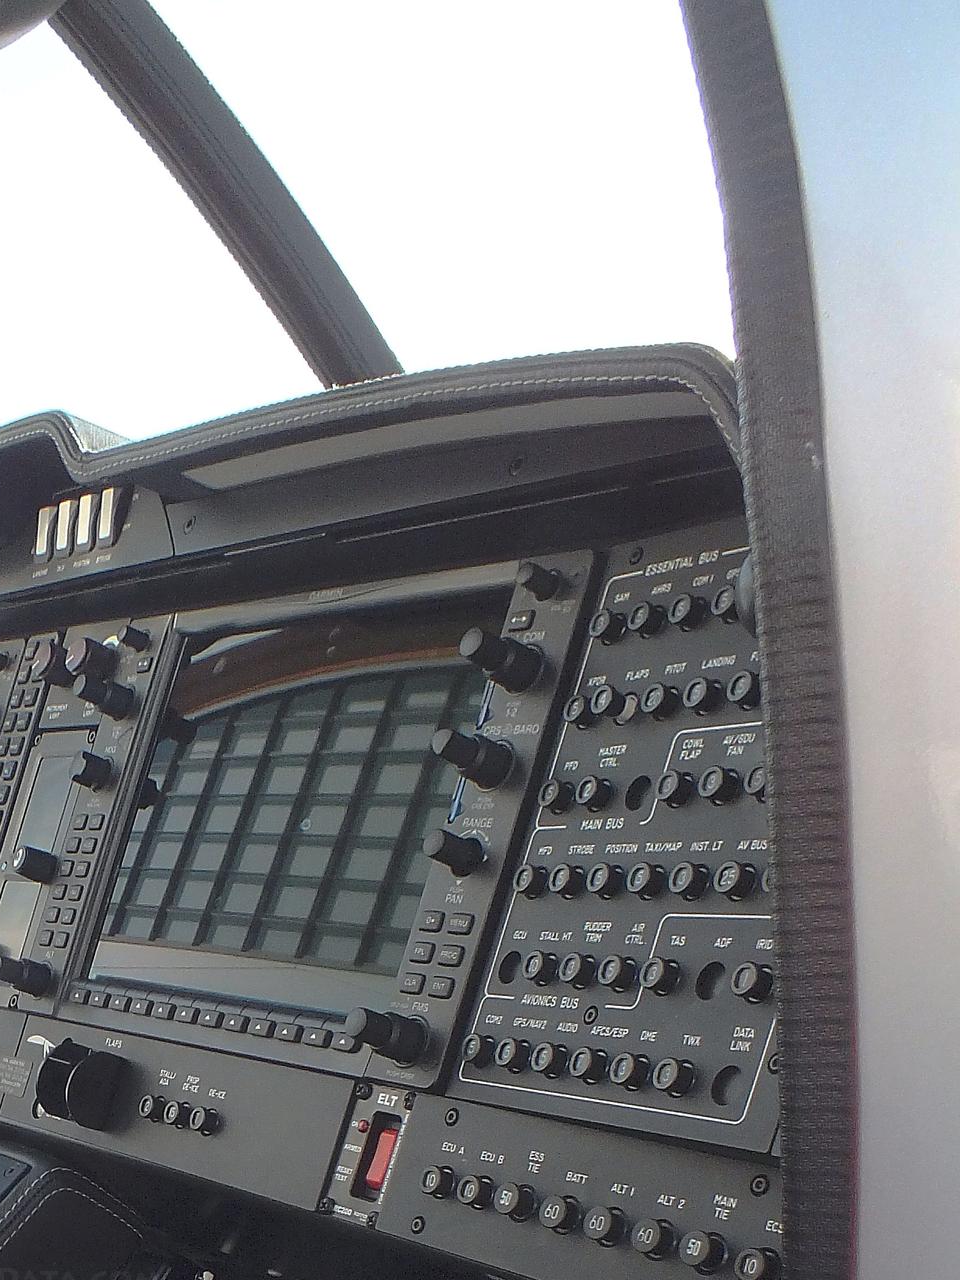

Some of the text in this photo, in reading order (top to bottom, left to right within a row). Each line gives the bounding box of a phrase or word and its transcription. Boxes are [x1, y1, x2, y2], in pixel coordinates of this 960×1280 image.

[645, 551, 719, 576] ESSENTIAL BUS
[523, 632, 545, 643] COM
[701, 655, 736, 669] LANDING
[625, 668, 650, 681] FLAPS
[665, 662, 688, 675] PITOT
[514, 724, 539, 735] BARO
[682, 738, 705, 749] COWL
[598, 745, 628, 756] MASTER
[679, 749, 702, 760] FLAP
[726, 746, 744, 756] FAN
[564, 761, 579, 771] PFD
[462, 817, 493, 828] RANGE
[580, 818, 624, 831] MAIN BUS
[568, 845, 596, 855] STROBE
[604, 843, 639, 854] POSITION
[712, 841, 724, 850] LT
[737, 839, 768, 850] AV BUS
[720, 869, 735, 884] 25
[445, 893, 464, 904] PAN
[583, 921, 612, 931] RUDDER
[631, 923, 645, 933] AIR
[540, 931, 560, 941] STALL
[585, 933, 602, 942] TRIM
[671, 936, 686, 946] TAS
[714, 938, 733, 948] ADF
[411, 1002, 429, 1012] FMS
[520, 994, 579, 1009] AVIONICS BUS
[513, 1017, 547, 1030] GPS/NAV2
[556, 1022, 578, 1033] AUDIO
[590, 1026, 629, 1038] AFCS/ESP
[640, 1030, 657, 1042] DME
[732, 1026, 755, 1039] DATA
[105, 1037, 122, 1048] FLAPS
[682, 1034, 702, 1047] TWX
[730, 1040, 752, 1052] LINK
[208, 1088, 227, 1099] DE-ICE
[377, 1093, 398, 1107] ELT
[344, 1143, 362, 1153] ARMED
[441, 1141, 465, 1155] ECU A
[480, 1151, 505, 1164] ECU B
[528, 1150, 545, 1162] ESS
[336, 1165, 353, 1174] RESET
[527, 1163, 540, 1174] TIE
[335, 1173, 348, 1182] TEST
[426, 1174, 436, 1187] 10
[565, 1171, 588, 1185] BATT
[464, 1185, 474, 1198] 10
[610, 1183, 628, 1195] ALT
[500, 1190, 512, 1205] 50
[657, 1194, 686, 1210] ALT 2
[713, 1194, 738, 1208] MAIN
[544, 1204, 559, 1219] 60
[714, 1208, 730, 1220] TIE
[589, 1214, 605, 1231] 60
[638, 1228, 653, 1244] 60
[687, 1239, 700, 1256] 50
[743, 1258, 756, 1274] 10
